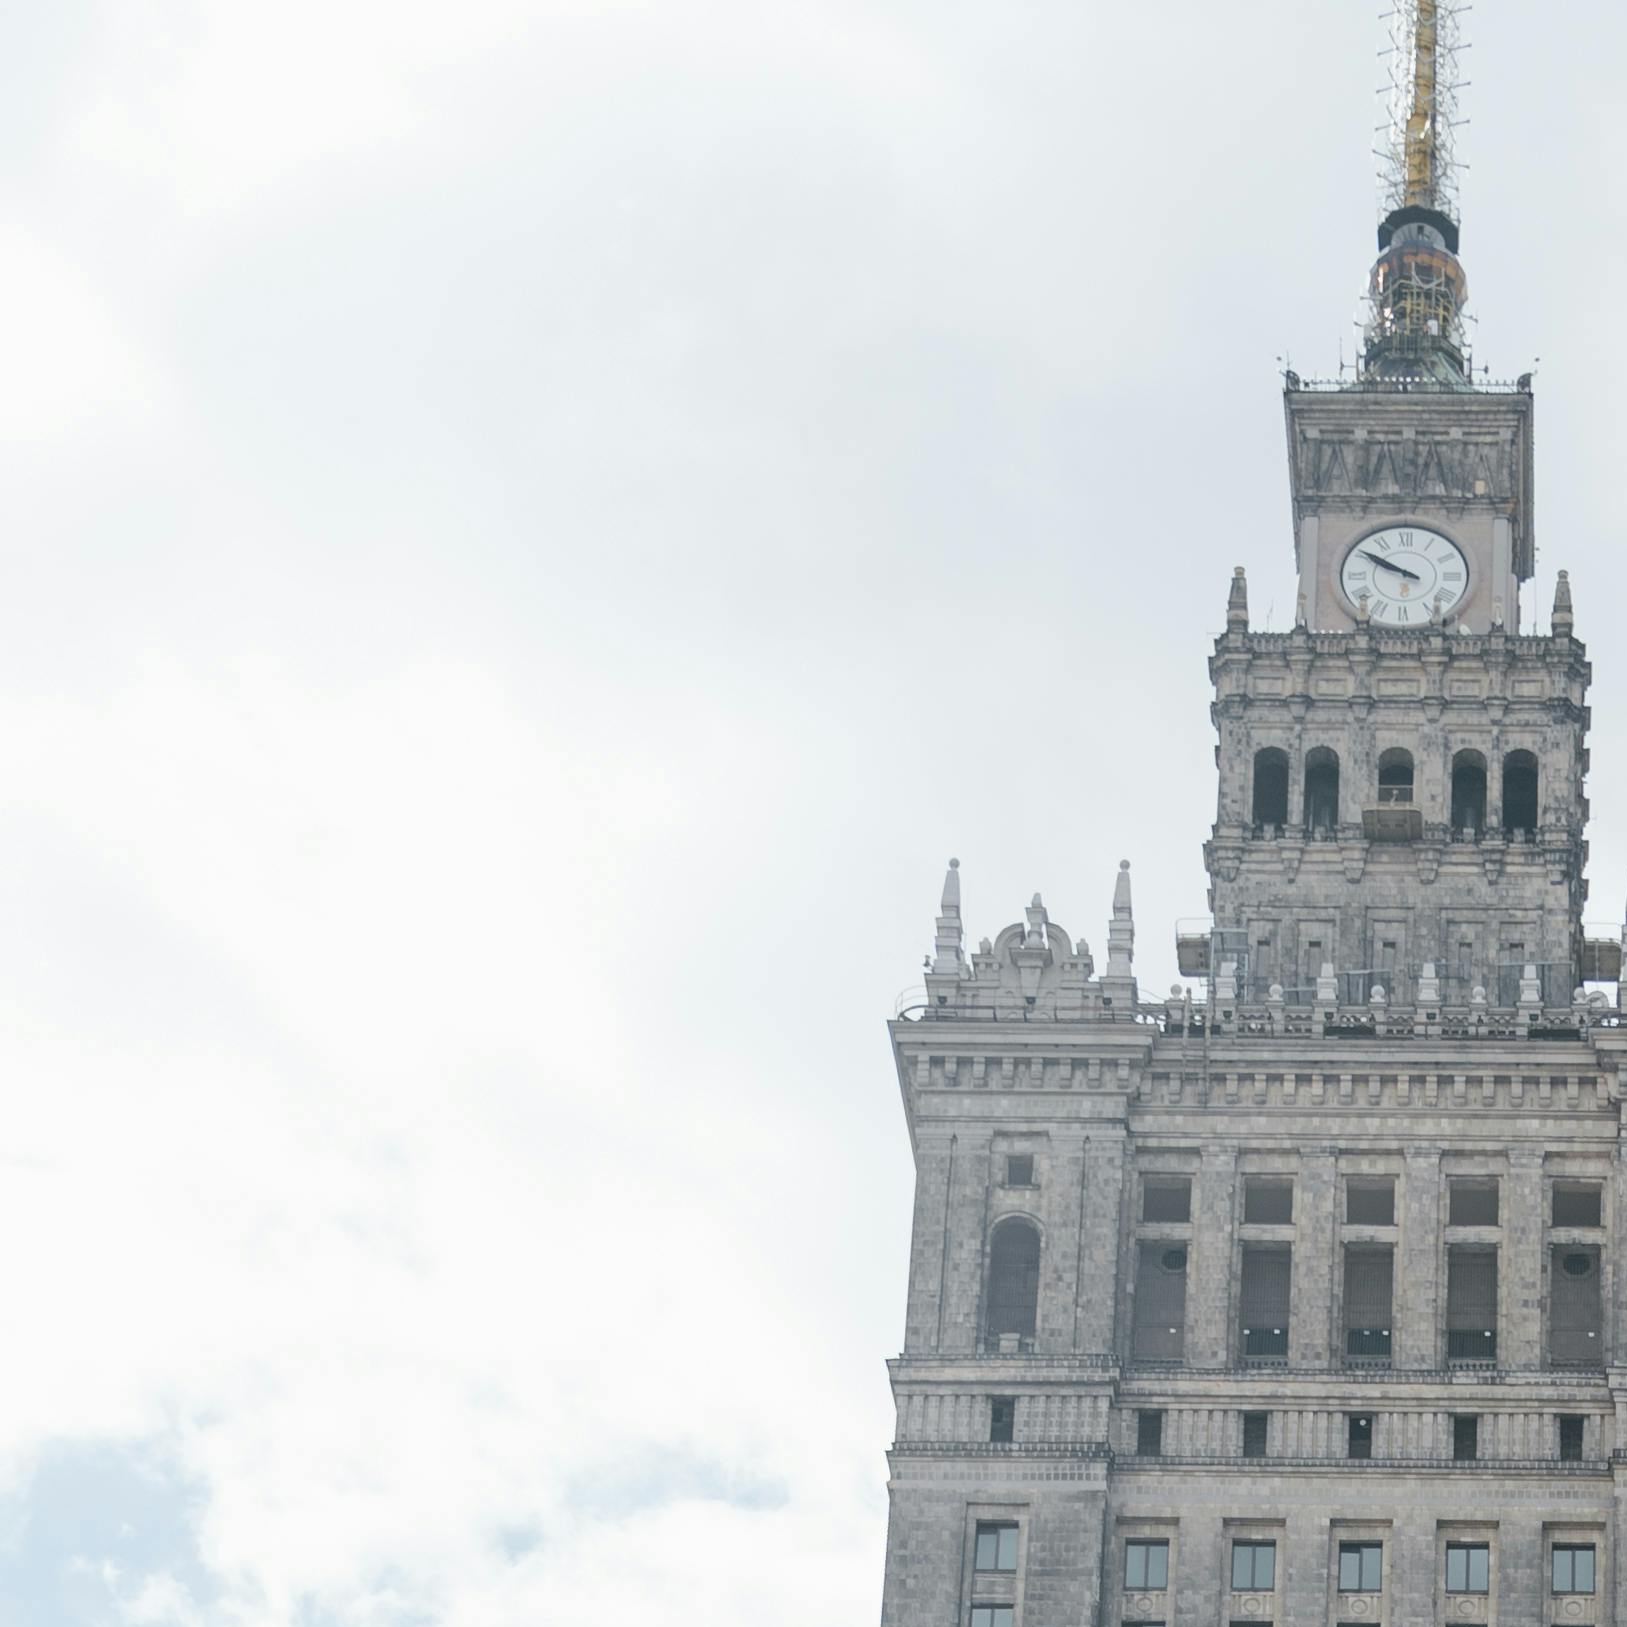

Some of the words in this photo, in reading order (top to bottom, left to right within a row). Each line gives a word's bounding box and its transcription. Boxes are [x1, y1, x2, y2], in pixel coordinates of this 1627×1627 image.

[1374, 536, 1391, 551] XI
[1398, 532, 1413, 547] XII
[1424, 538, 1434, 551] I
[1348, 571, 1366, 580] IX
[1443, 572, 1461, 581] III
[1398, 606, 1408, 621] VI
